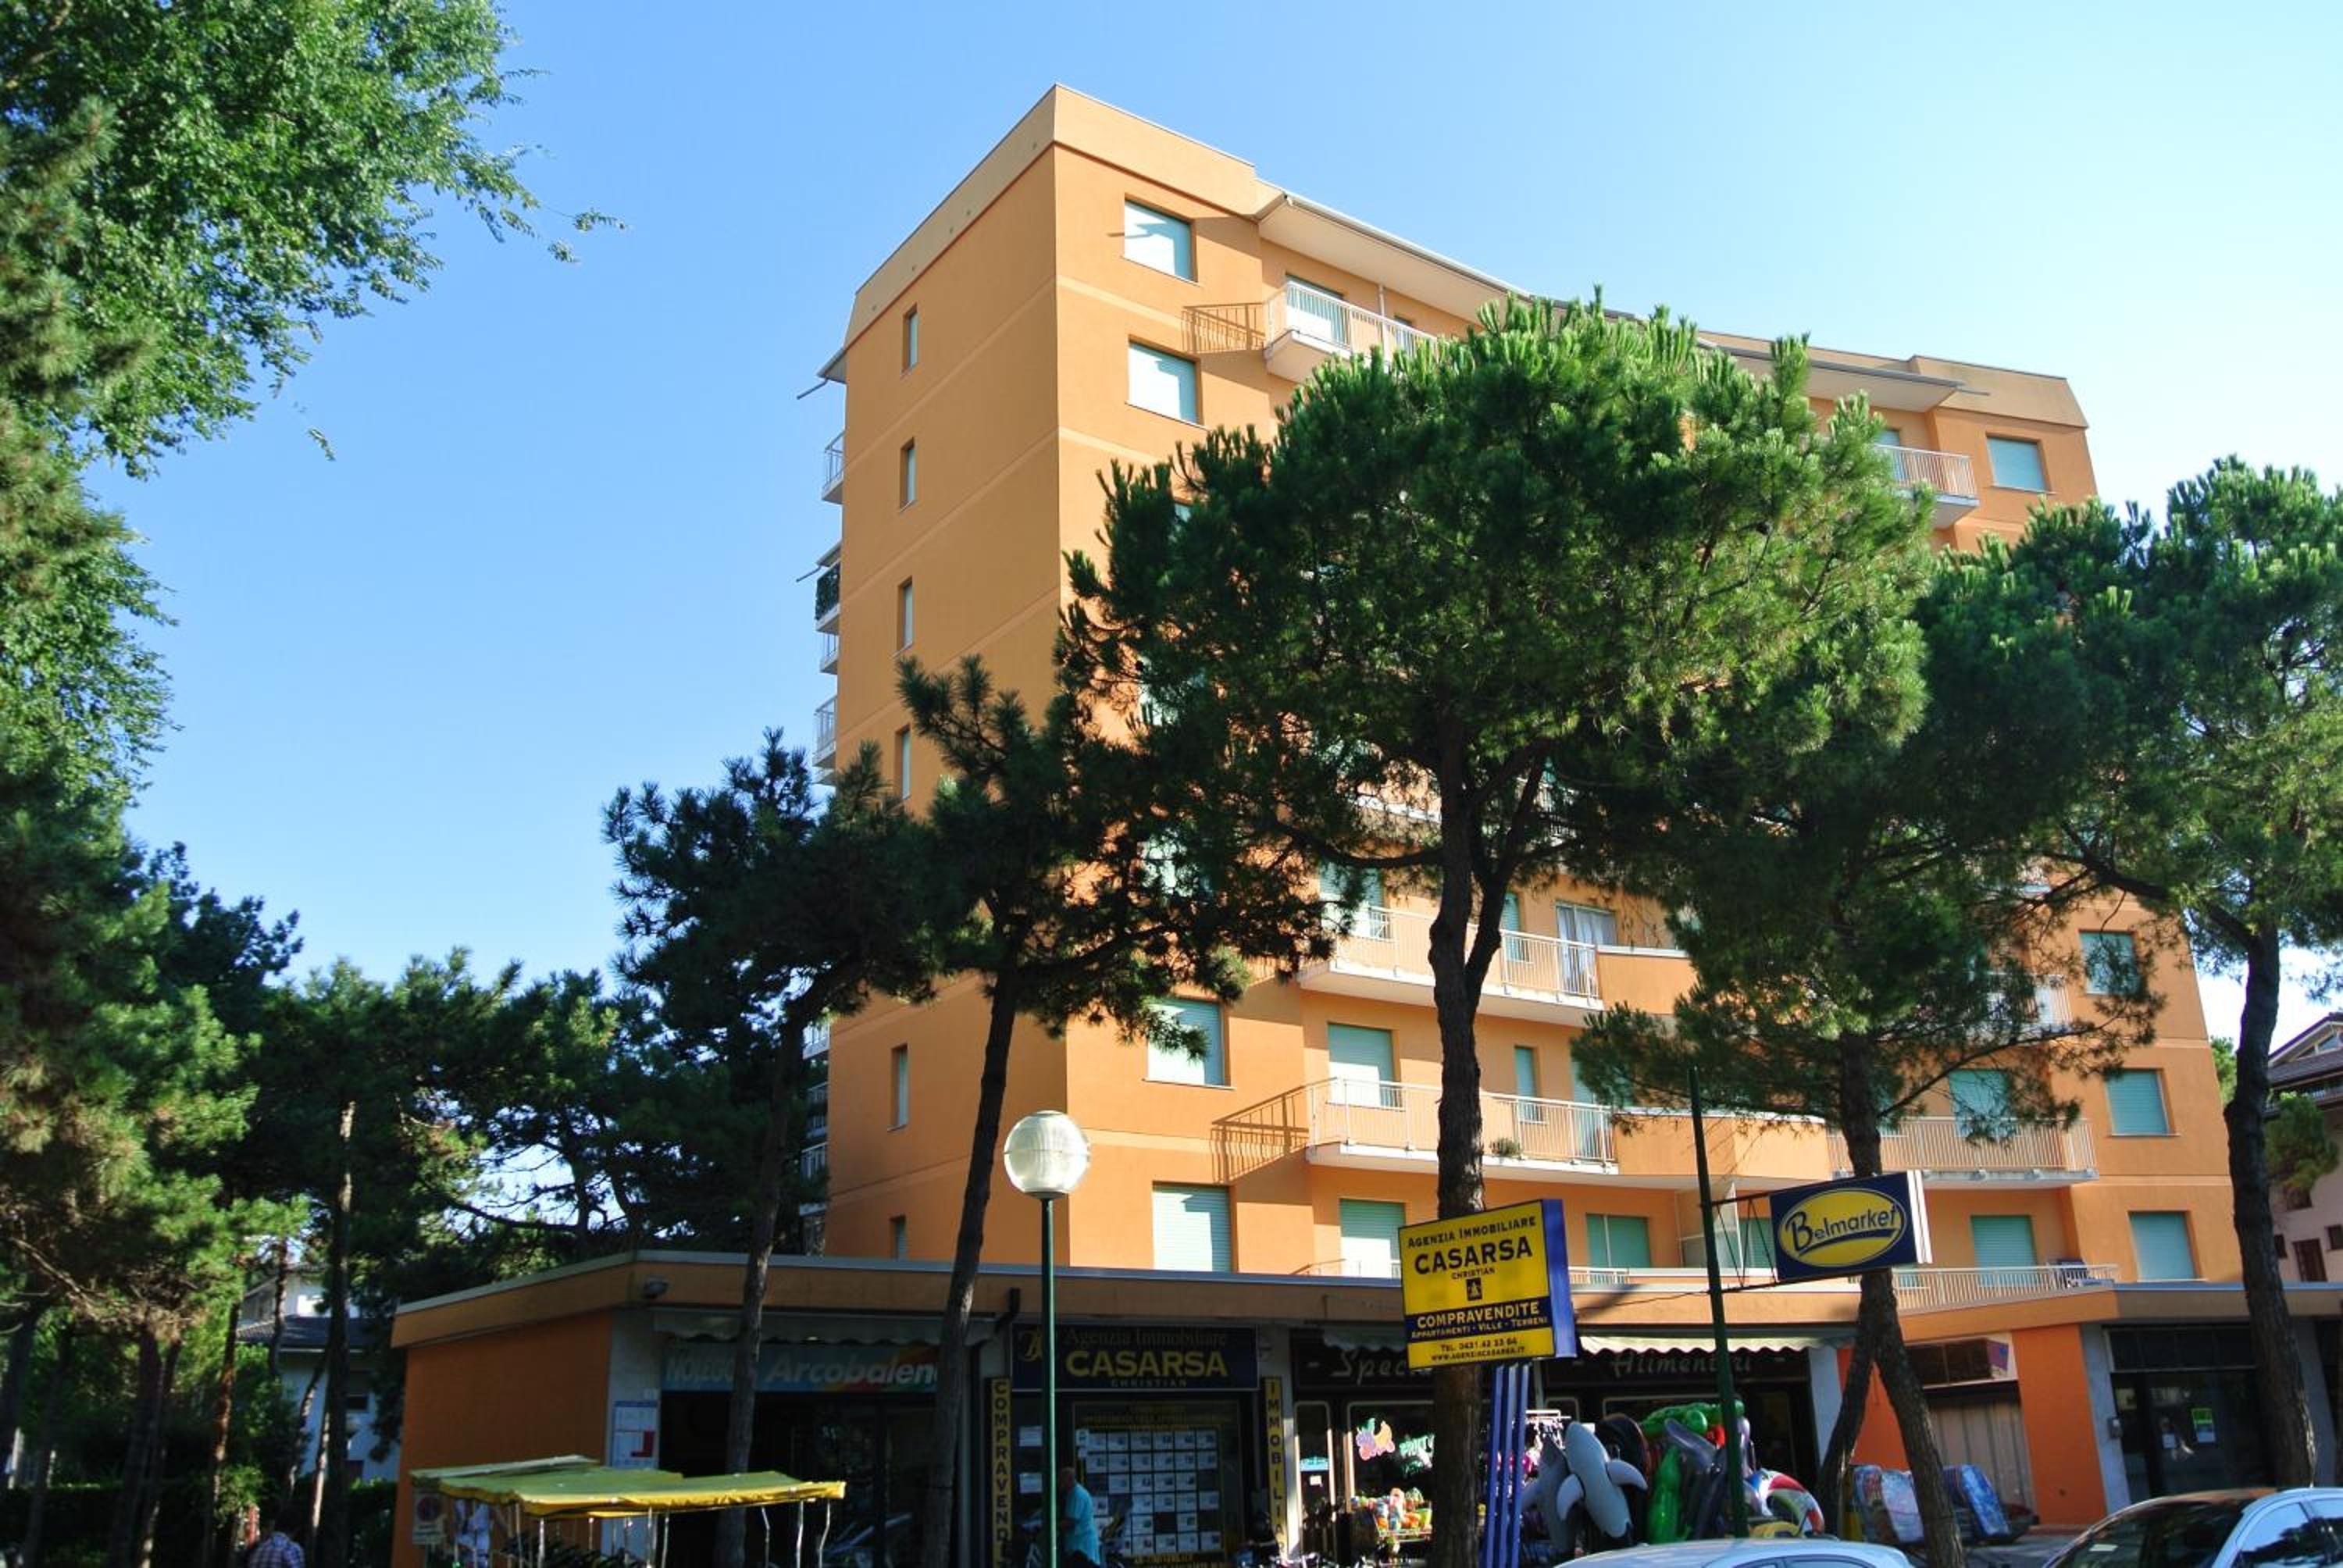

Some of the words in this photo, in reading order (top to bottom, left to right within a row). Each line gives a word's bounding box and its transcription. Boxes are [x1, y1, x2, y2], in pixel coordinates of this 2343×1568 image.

[1408, 1231, 1455, 1249] AGENZIA
[1459, 1216, 1536, 1239] IMMOBILIARE
[1786, 1204, 1896, 1251] Belmarket
[1414, 1235, 1533, 1274] CASARSA
[1452, 1267, 1496, 1280] CHRISTIAN
[1418, 1302, 1539, 1329] COMPRAVENDITE
[1066, 1350, 1228, 1377] CASARSA
[1610, 1351, 1752, 1377] Alimentri
